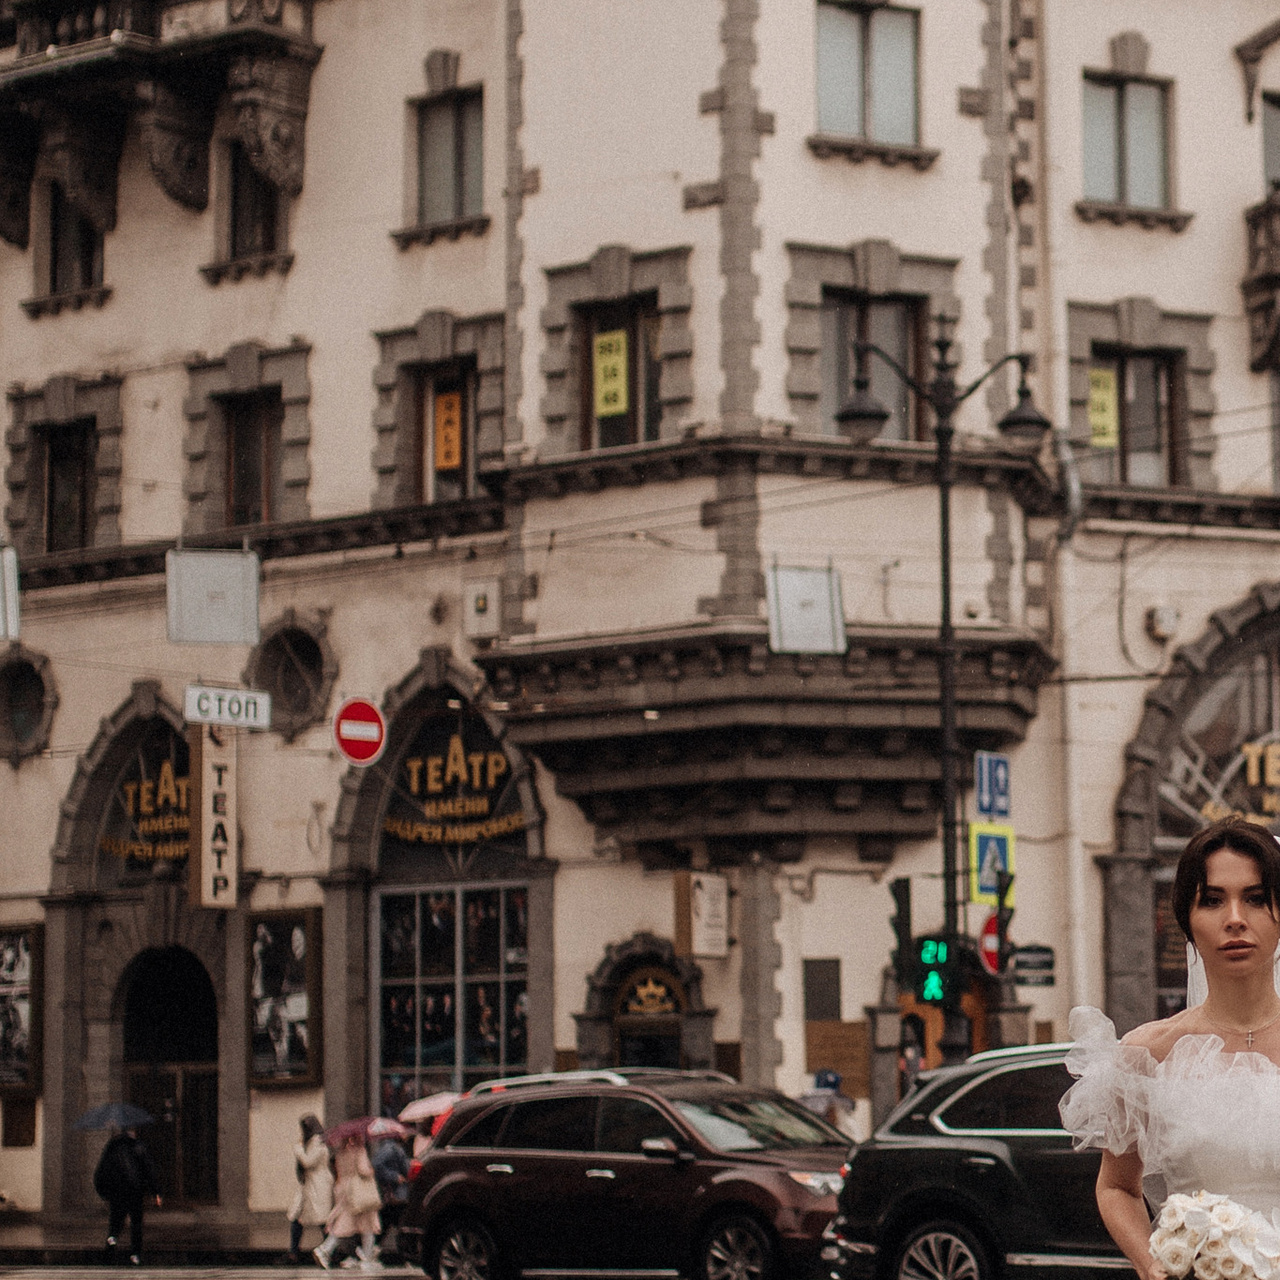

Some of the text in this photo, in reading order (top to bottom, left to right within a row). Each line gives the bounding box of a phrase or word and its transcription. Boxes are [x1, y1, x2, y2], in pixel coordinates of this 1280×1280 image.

[197, 693, 257, 719] СТОП
[123, 760, 190, 816] ТЕАТ
[405, 734, 507, 795] ТЕАТР
[212, 764, 228, 899] ТЕАТР
